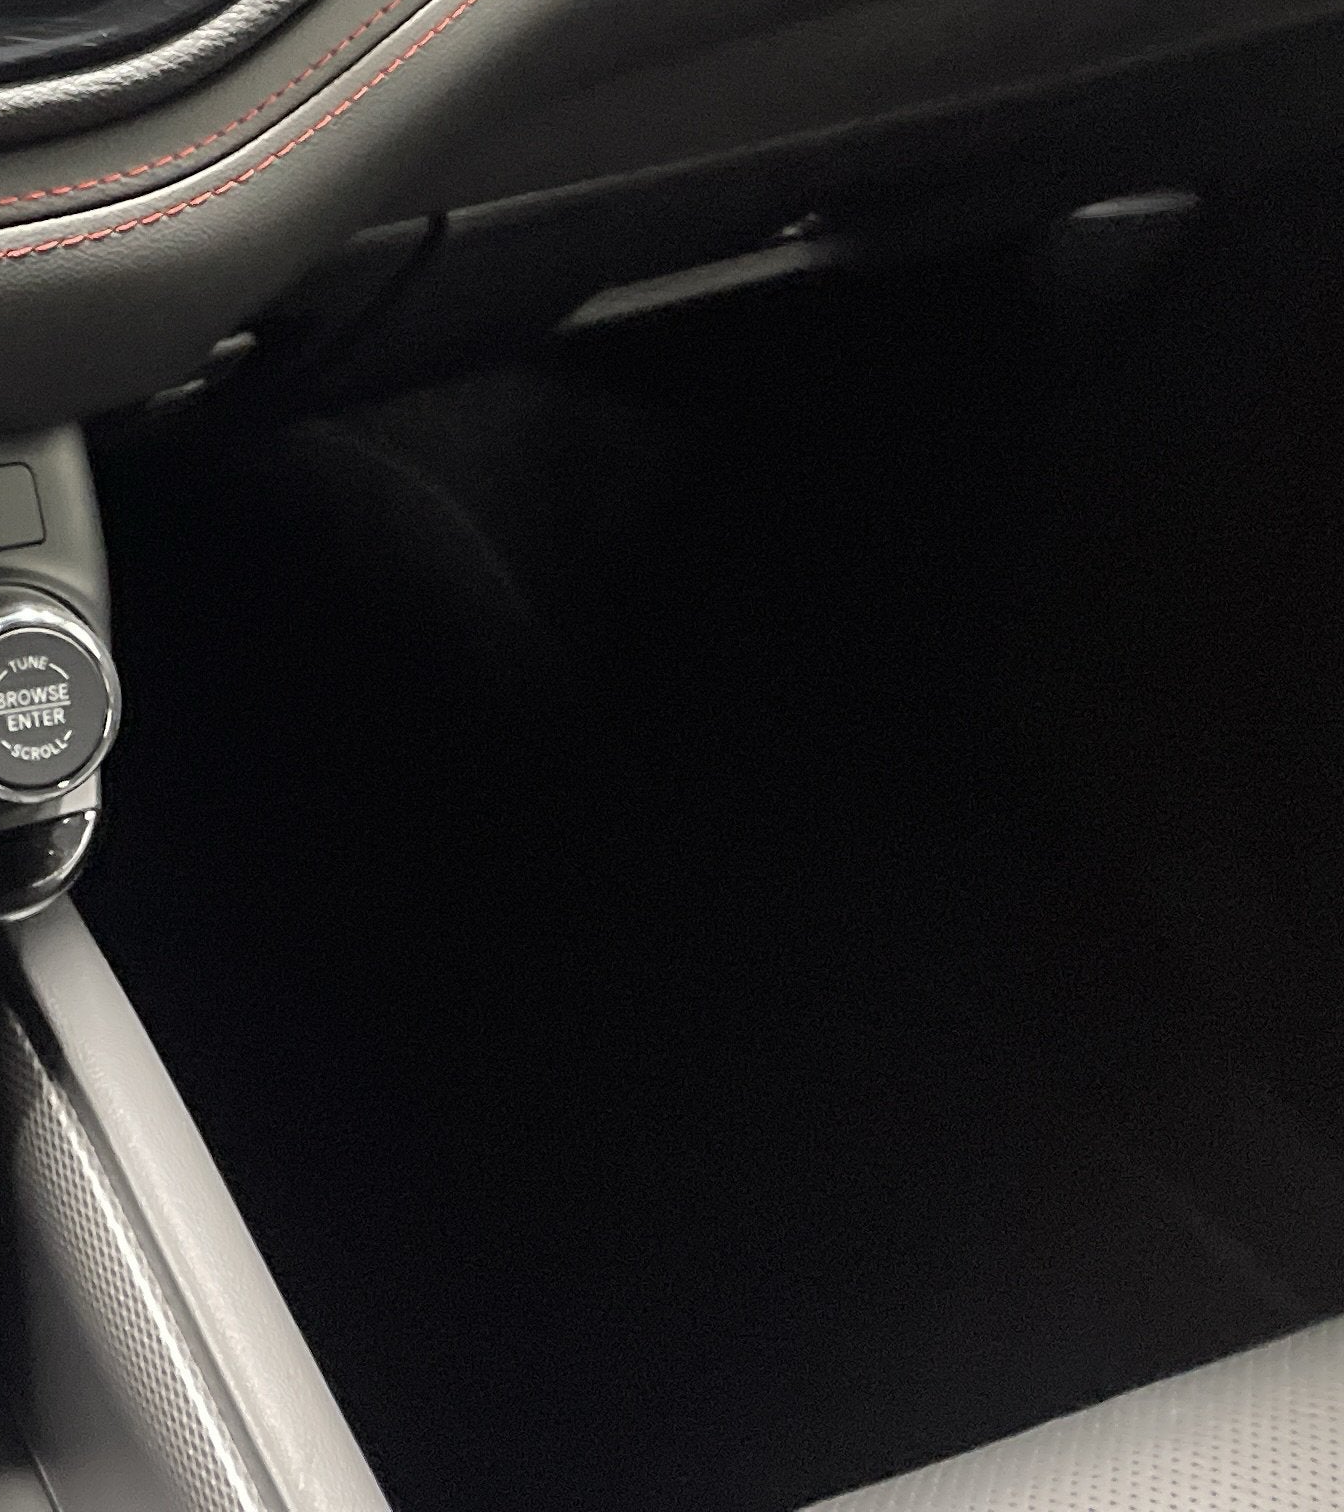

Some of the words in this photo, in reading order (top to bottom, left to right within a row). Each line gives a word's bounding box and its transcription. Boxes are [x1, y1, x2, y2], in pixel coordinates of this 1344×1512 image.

[9, 656, 49, 674] TUNE
[6, 708, 66, 732] ENTER
[10, 738, 66, 761] SCROLL
